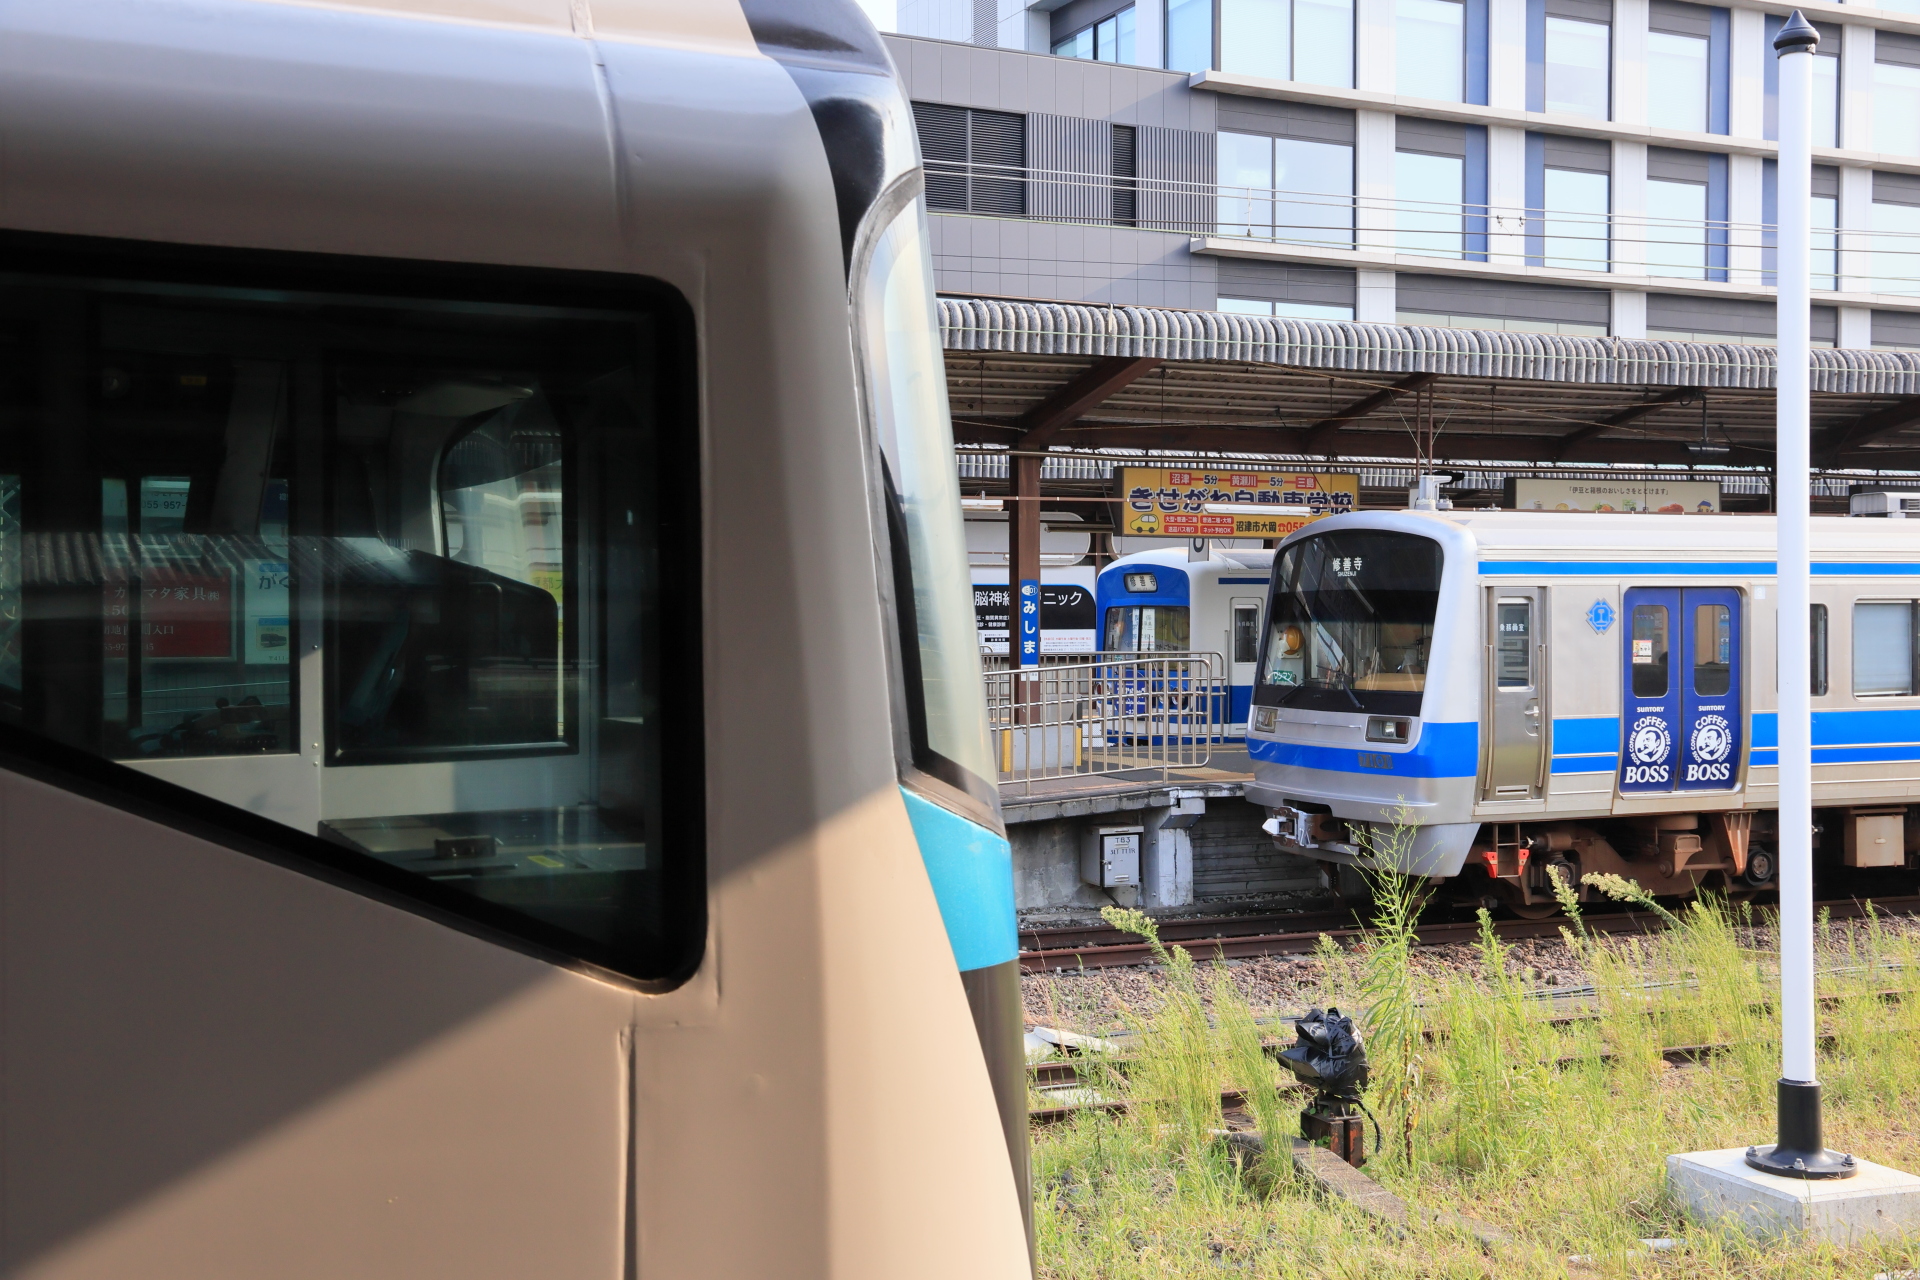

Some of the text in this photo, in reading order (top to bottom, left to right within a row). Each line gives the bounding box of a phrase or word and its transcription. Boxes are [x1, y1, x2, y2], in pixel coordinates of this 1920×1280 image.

[1172, 474, 1315, 487] 沼津 5分 黄瀬川 5分 三島
[1236, 521, 1277, 532] 沼津市大岡
[1332, 556, 1362, 572] 修善寺
[1023, 601, 1036, 654] みしま
[1634, 716, 1668, 731] COFFEE
[1695, 714, 1729, 729] COFFEE
[1358, 754, 1391, 768] 7101
[1624, 765, 1669, 783] BOSS
[1686, 763, 1730, 781] BOSS
